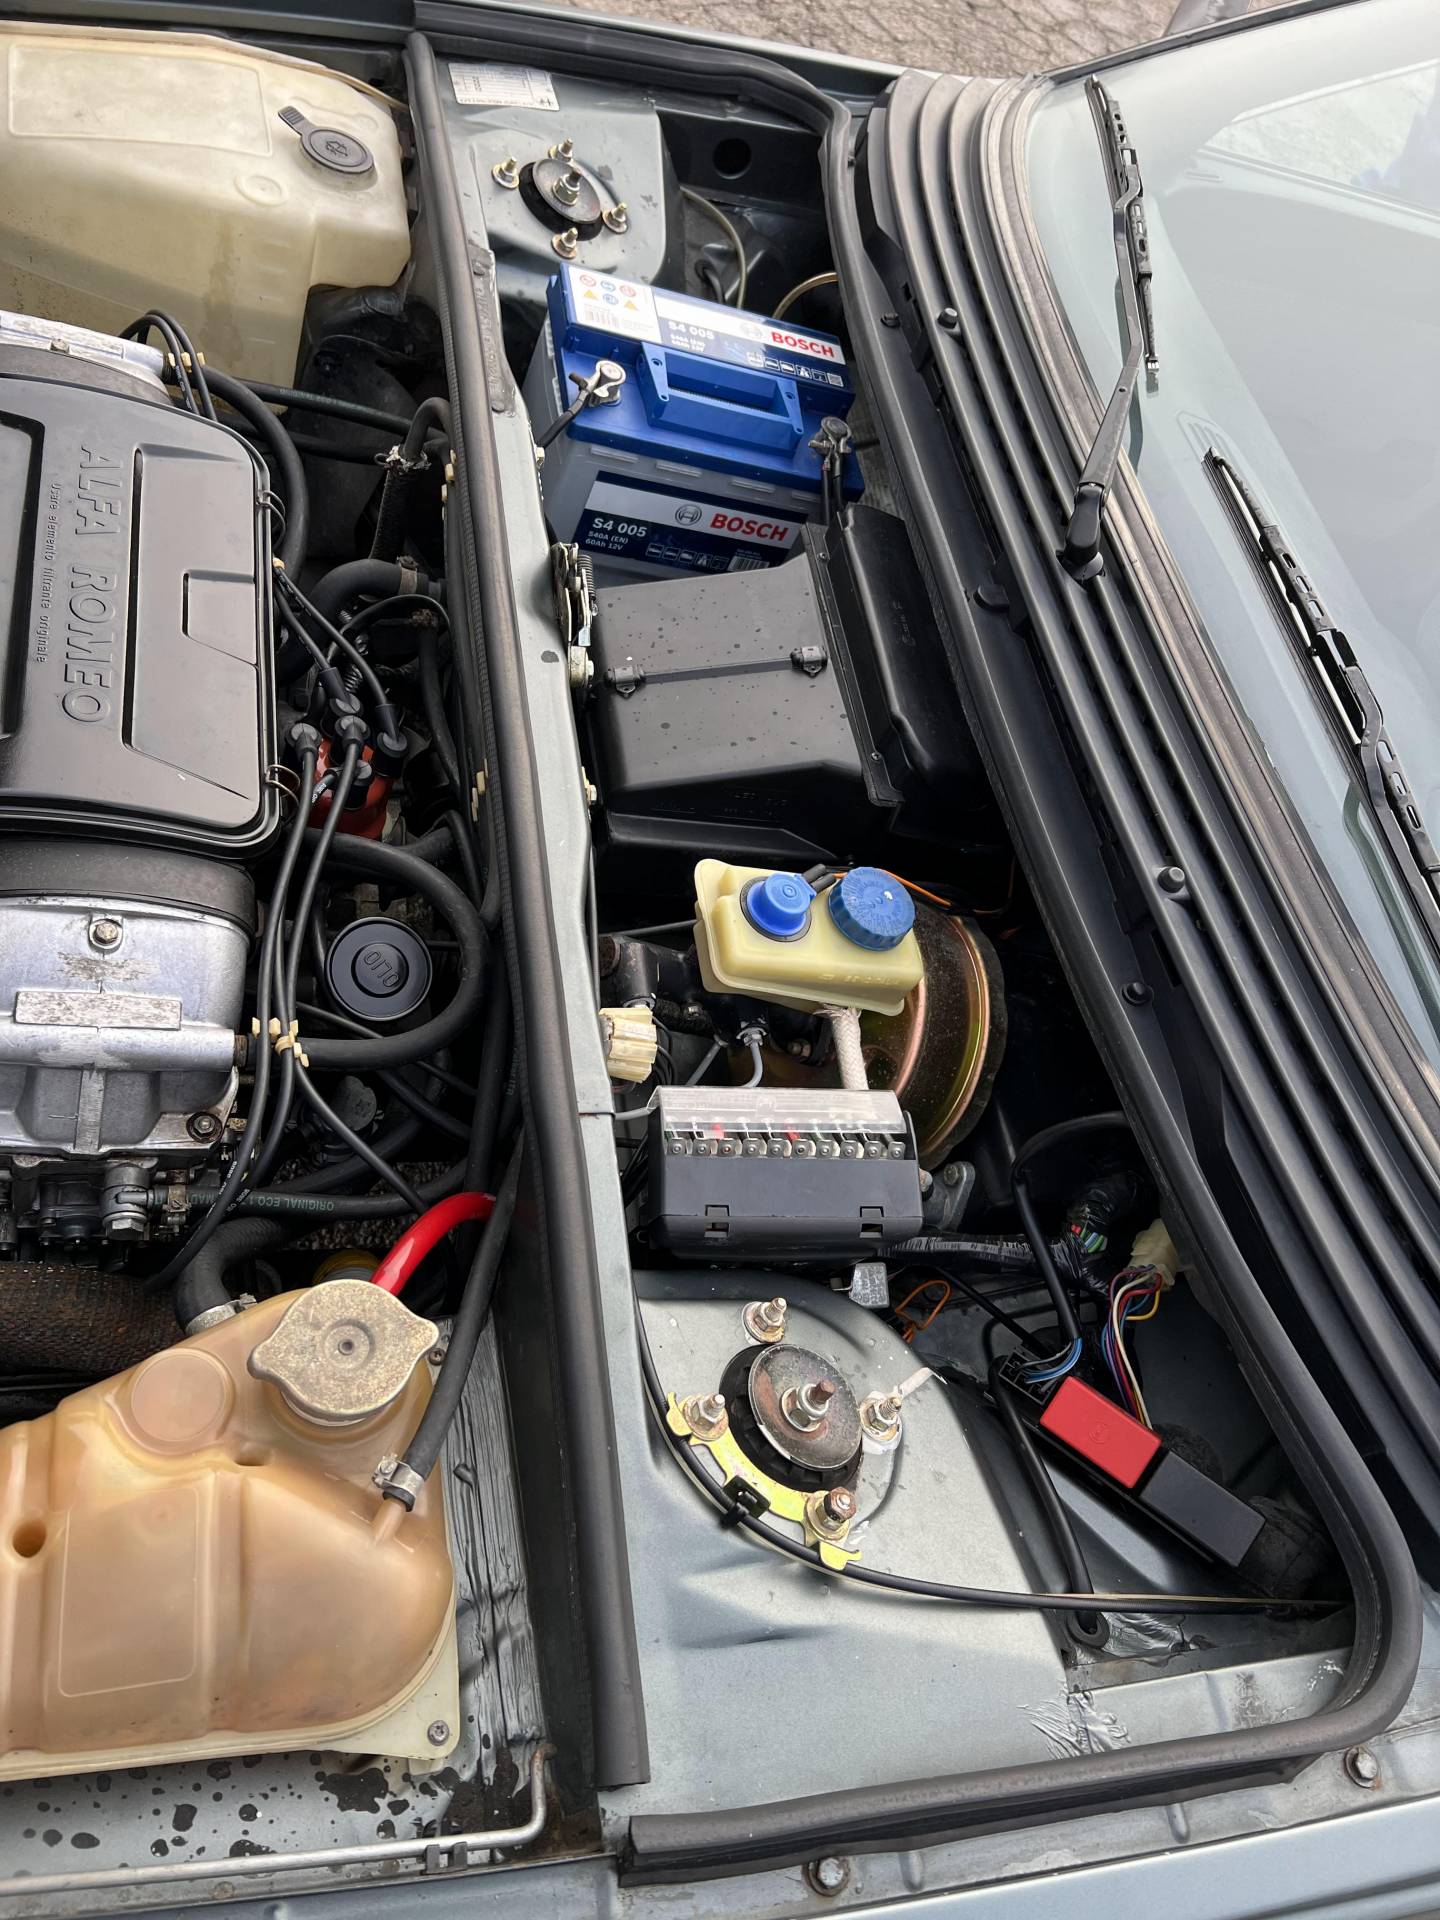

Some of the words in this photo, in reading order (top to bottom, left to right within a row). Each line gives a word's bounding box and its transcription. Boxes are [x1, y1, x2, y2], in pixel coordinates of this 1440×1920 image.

[689, 326, 715, 340] 005
[771, 331, 835, 358] BOSCH
[75, 445, 123, 535] ALFA
[592, 518, 614, 531] S4
[617, 522, 648, 537] 005
[710, 513, 789, 541] BOSCH
[607, 543, 624, 551] 12V
[62, 564, 118, 723] ROMEO
[363, 951, 400, 988] OLIO
[286, 1199, 335, 1212] ORIGINAL
